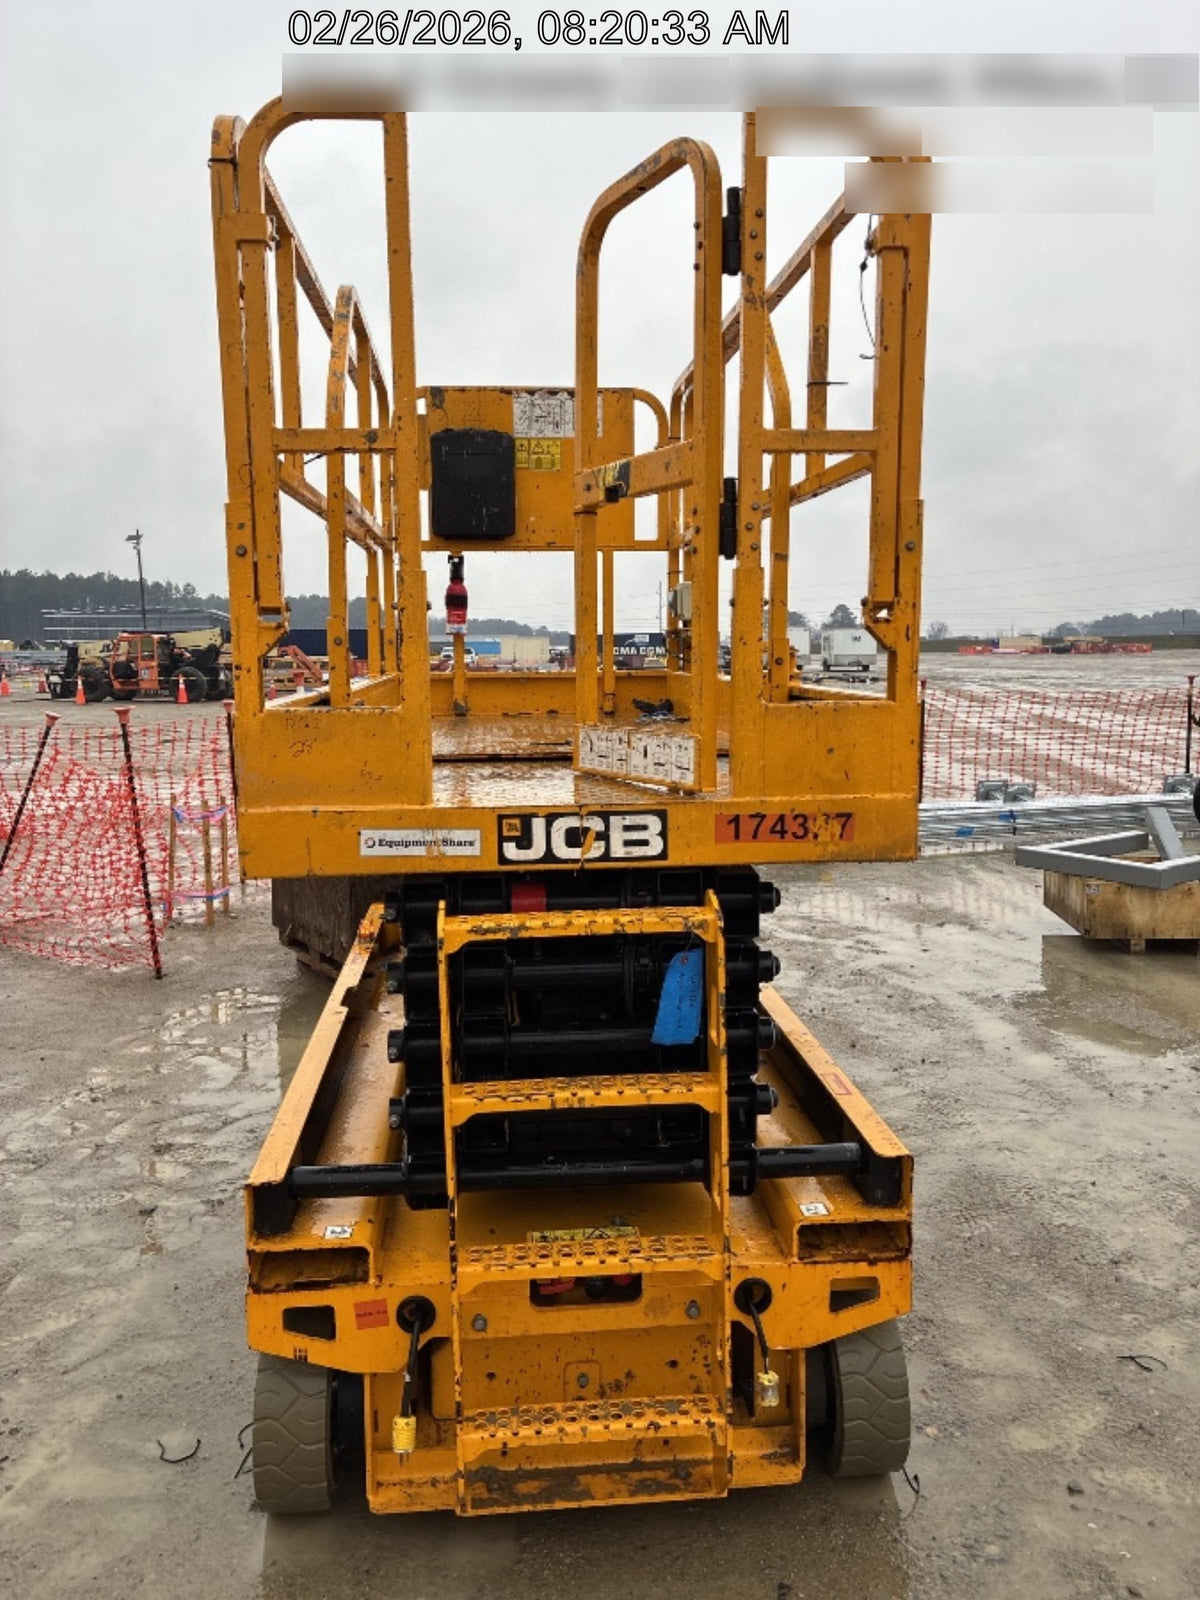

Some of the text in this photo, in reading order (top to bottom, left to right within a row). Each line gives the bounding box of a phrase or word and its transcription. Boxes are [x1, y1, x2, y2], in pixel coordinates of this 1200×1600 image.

[502, 814, 664, 861] JCB
[727, 812, 853, 840] 17437
[378, 838, 476, 849] EquipmenShare
